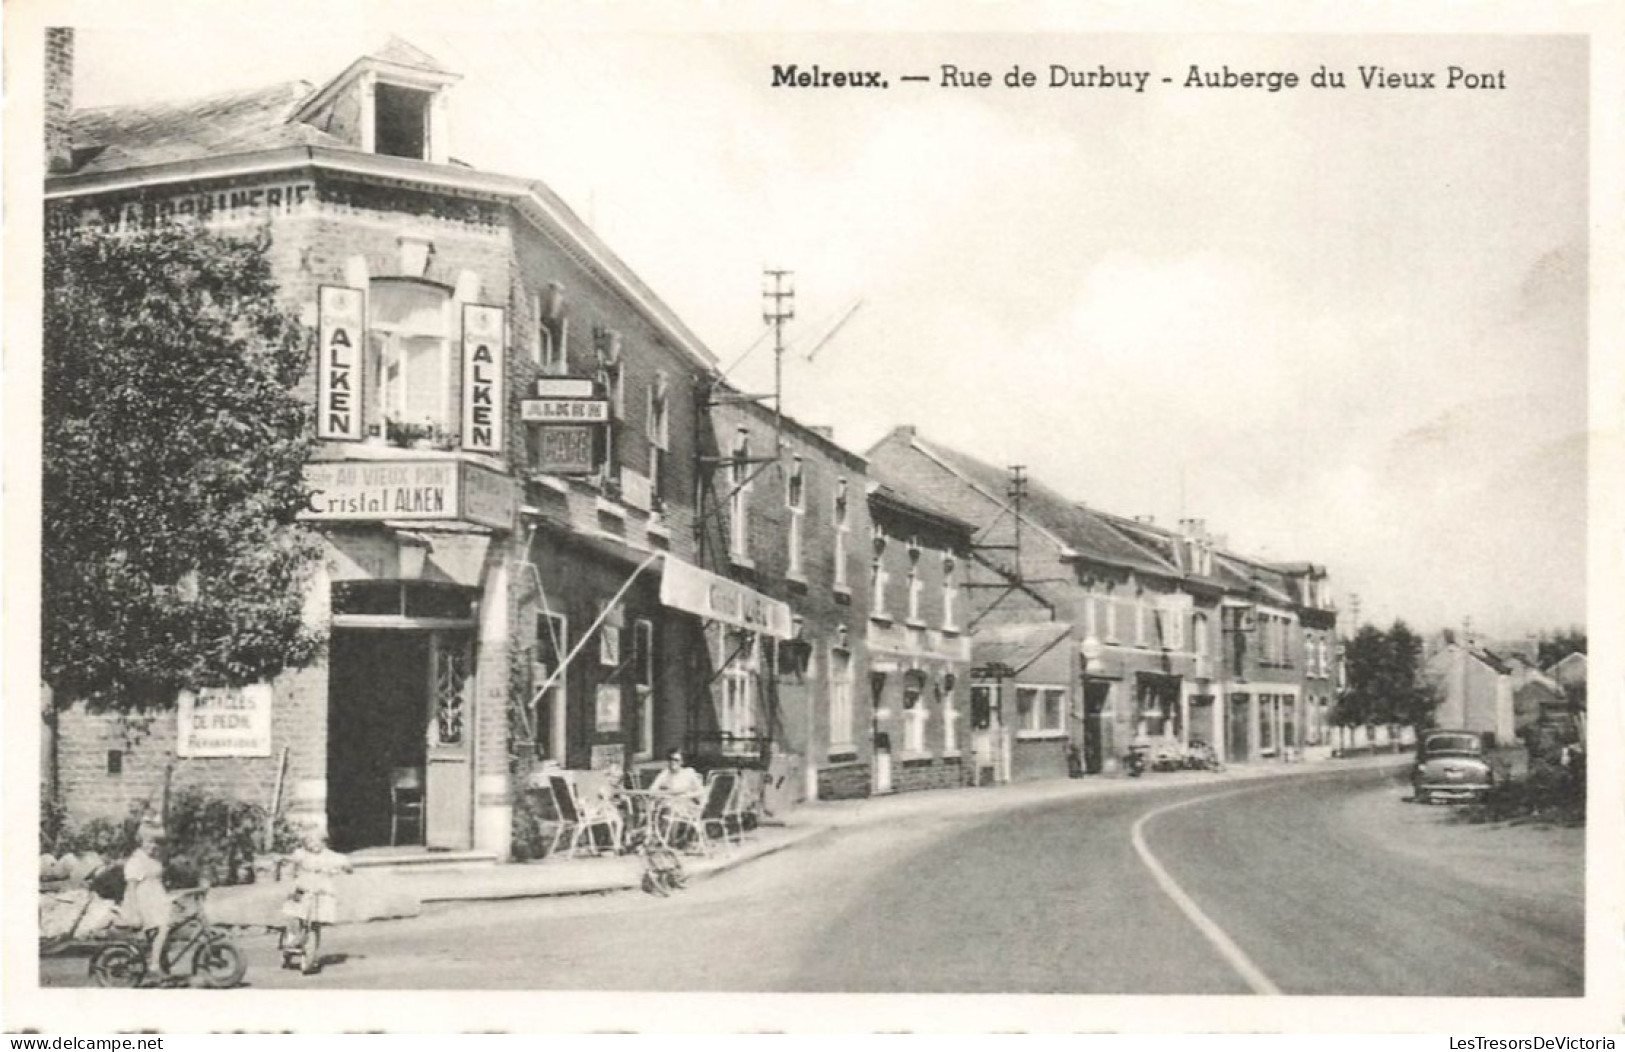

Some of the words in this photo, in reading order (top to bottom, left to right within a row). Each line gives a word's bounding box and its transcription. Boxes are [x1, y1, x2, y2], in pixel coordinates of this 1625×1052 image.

[329, 327, 352, 435] ALKEN
[472, 344, 494, 448] ALKEN
[526, 402, 602, 417] ALKEN
[336, 468, 357, 487] AU
[362, 467, 408, 486] VIEUX
[305, 489, 389, 513] Cristal
[394, 487, 444, 513] ALKEN
